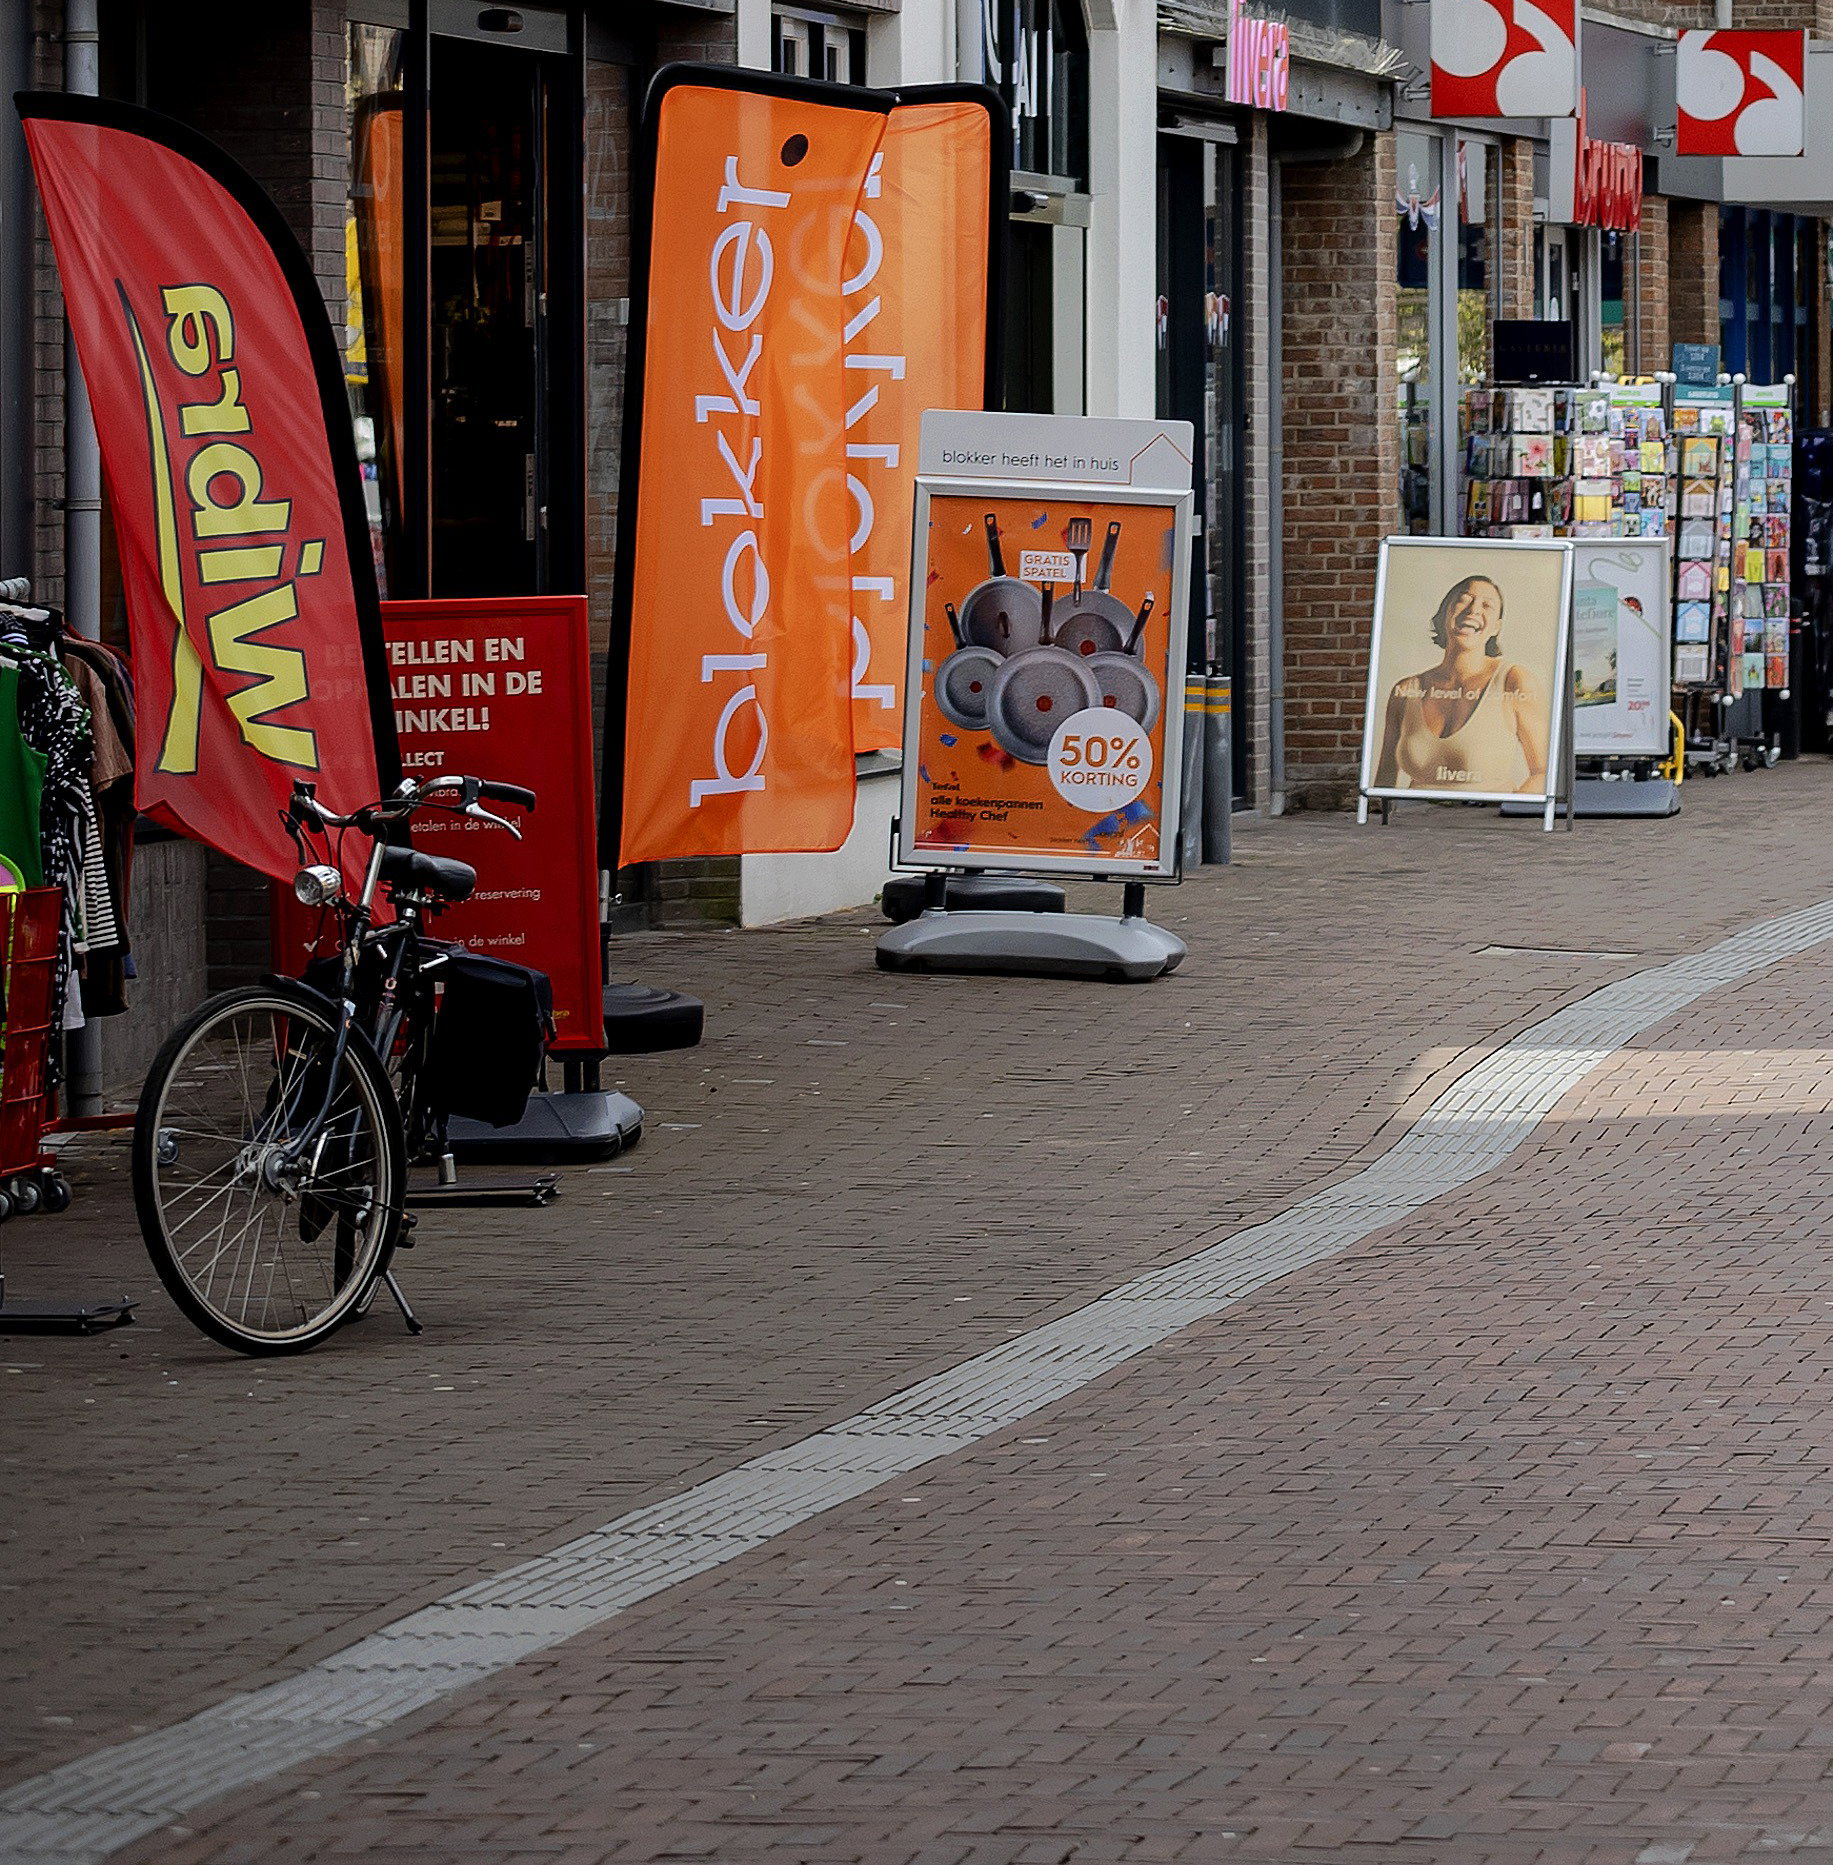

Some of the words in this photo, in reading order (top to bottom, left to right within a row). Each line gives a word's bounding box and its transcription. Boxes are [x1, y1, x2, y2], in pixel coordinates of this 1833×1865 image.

[942, 450, 996, 465] blokker
[1002, 453, 1040, 467] heeft
[1045, 455, 1068, 468] het
[1073, 455, 1086, 469] in
[1090, 457, 1119, 471] huis
[1024, 554, 1070, 566] GRATIS
[1023, 567, 1067, 578] SPATEL
[385, 639, 474, 665] ELLEN
[485, 638, 525, 662] EN
[462, 673, 496, 696] IN
[506, 671, 543, 695] DE
[1431, 687, 1462, 699] level
[396, 707, 490, 733] INKEL!
[1060, 735, 1141, 770] 50%
[1060, 771, 1139, 787] KORTING
[954, 796, 1043, 811] koekenpannen
[979, 810, 1008, 822] Chef
[411, 820, 447, 833] etalen
[450, 819, 461, 831] in
[464, 818, 480, 831] de
[475, 888, 541, 901] reservering
[468, 934, 484, 947] de
[488, 932, 526, 947] winkel
